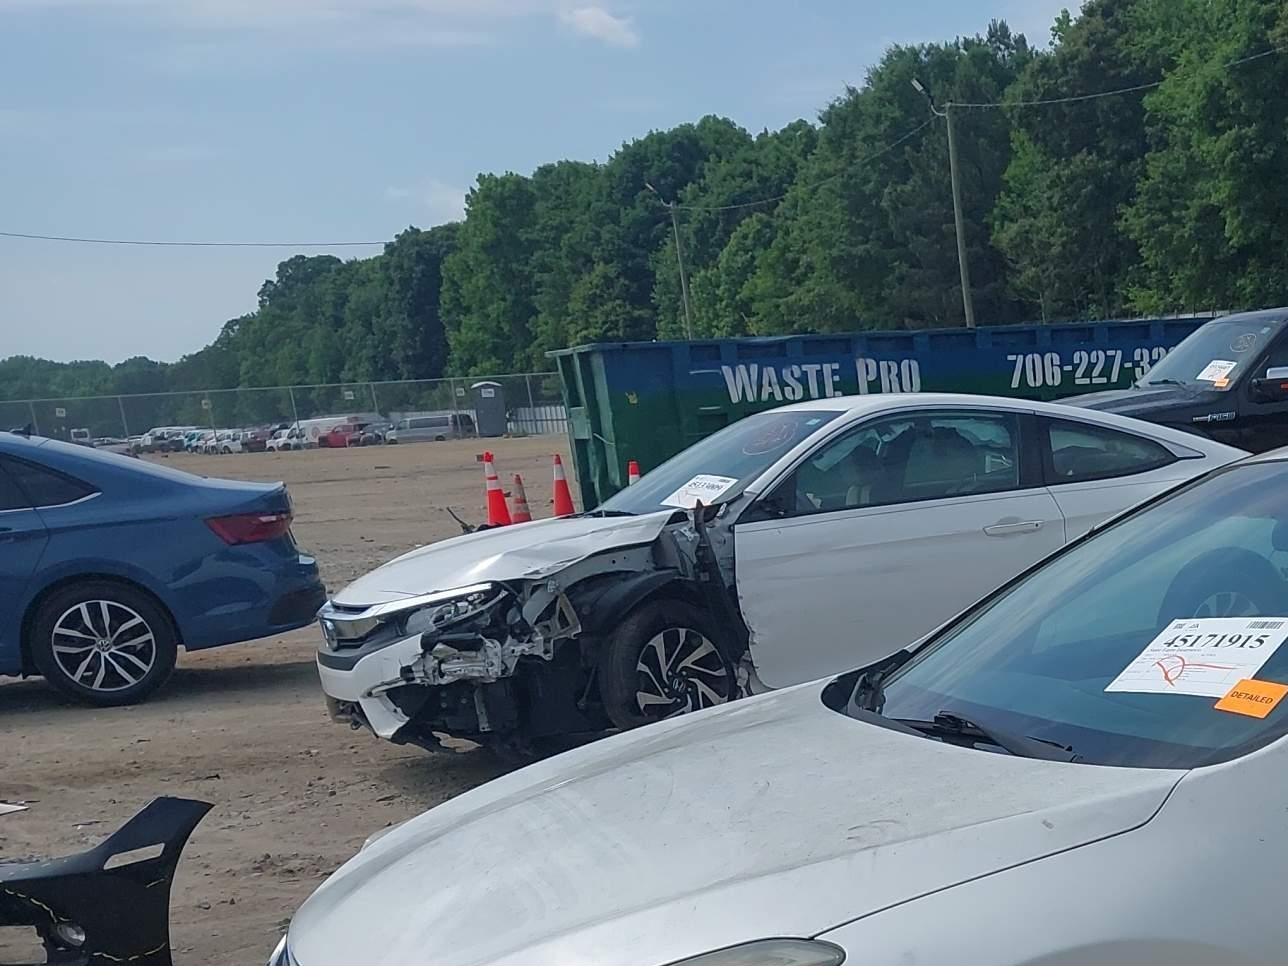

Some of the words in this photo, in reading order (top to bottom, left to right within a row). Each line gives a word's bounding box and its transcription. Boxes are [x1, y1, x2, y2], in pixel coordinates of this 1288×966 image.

[856, 357, 920, 394] PRO
[1007, 346, 1176, 389] 706-227-32
[1163, 633, 1271, 648] 45171915
[1231, 690, 1274, 704] DETAILED
